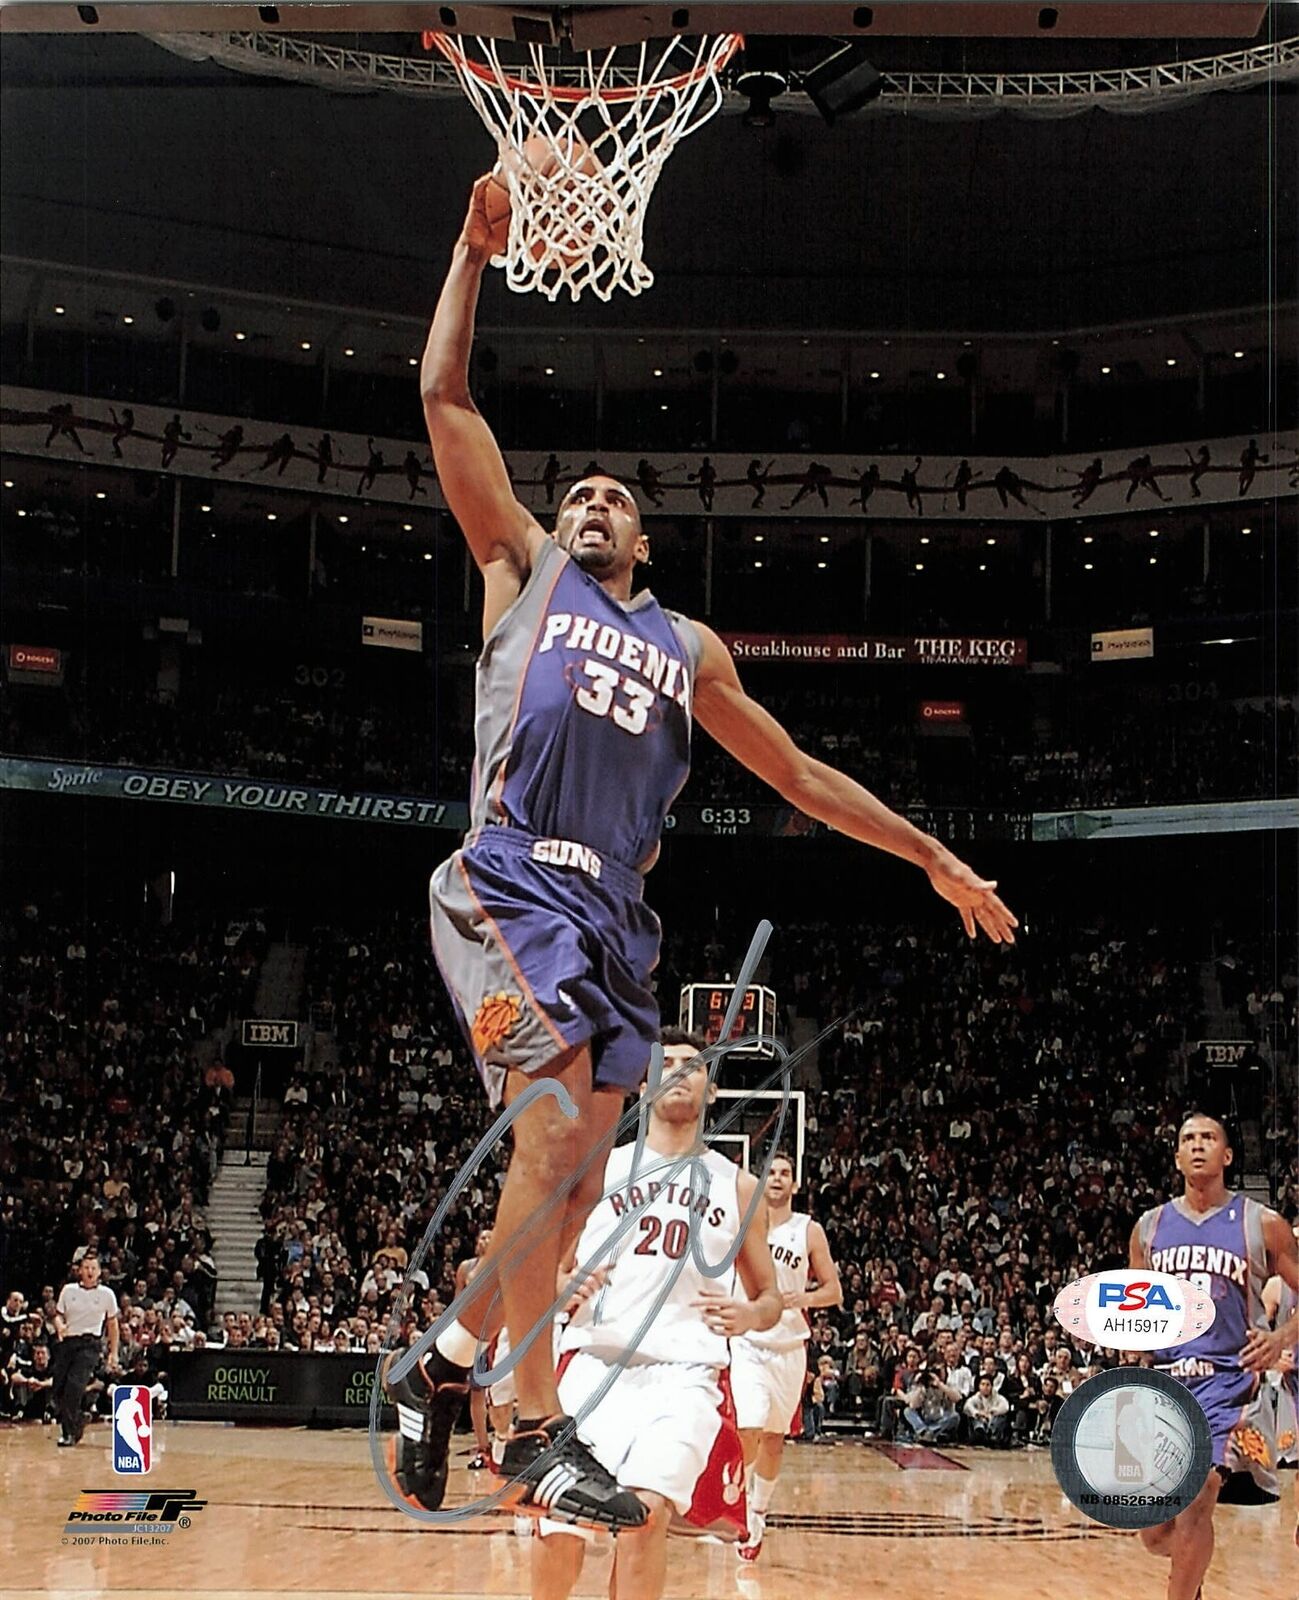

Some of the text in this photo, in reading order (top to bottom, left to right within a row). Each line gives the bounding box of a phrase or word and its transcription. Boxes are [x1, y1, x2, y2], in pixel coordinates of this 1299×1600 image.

[733, 638, 1015, 659] Steakhouse and Bar THE KEG
[575, 658, 655, 735] 33
[48, 768, 446, 824] Sprite OBEY YOUR THIRST!
[701, 808, 751, 824] 6:33
[713, 824, 737, 835] 3rd
[532, 840, 602, 879] SUNS
[250, 1025, 290, 1043] IBM
[1206, 1046, 1246, 1063] IBM
[609, 1181, 726, 1228] RAPTORS
[634, 1215, 690, 1260] 20
[1151, 1245, 1247, 1286] PHOENIX
[215, 1367, 271, 1384] OGILVY
[207, 1384, 277, 1402] RENAULT
